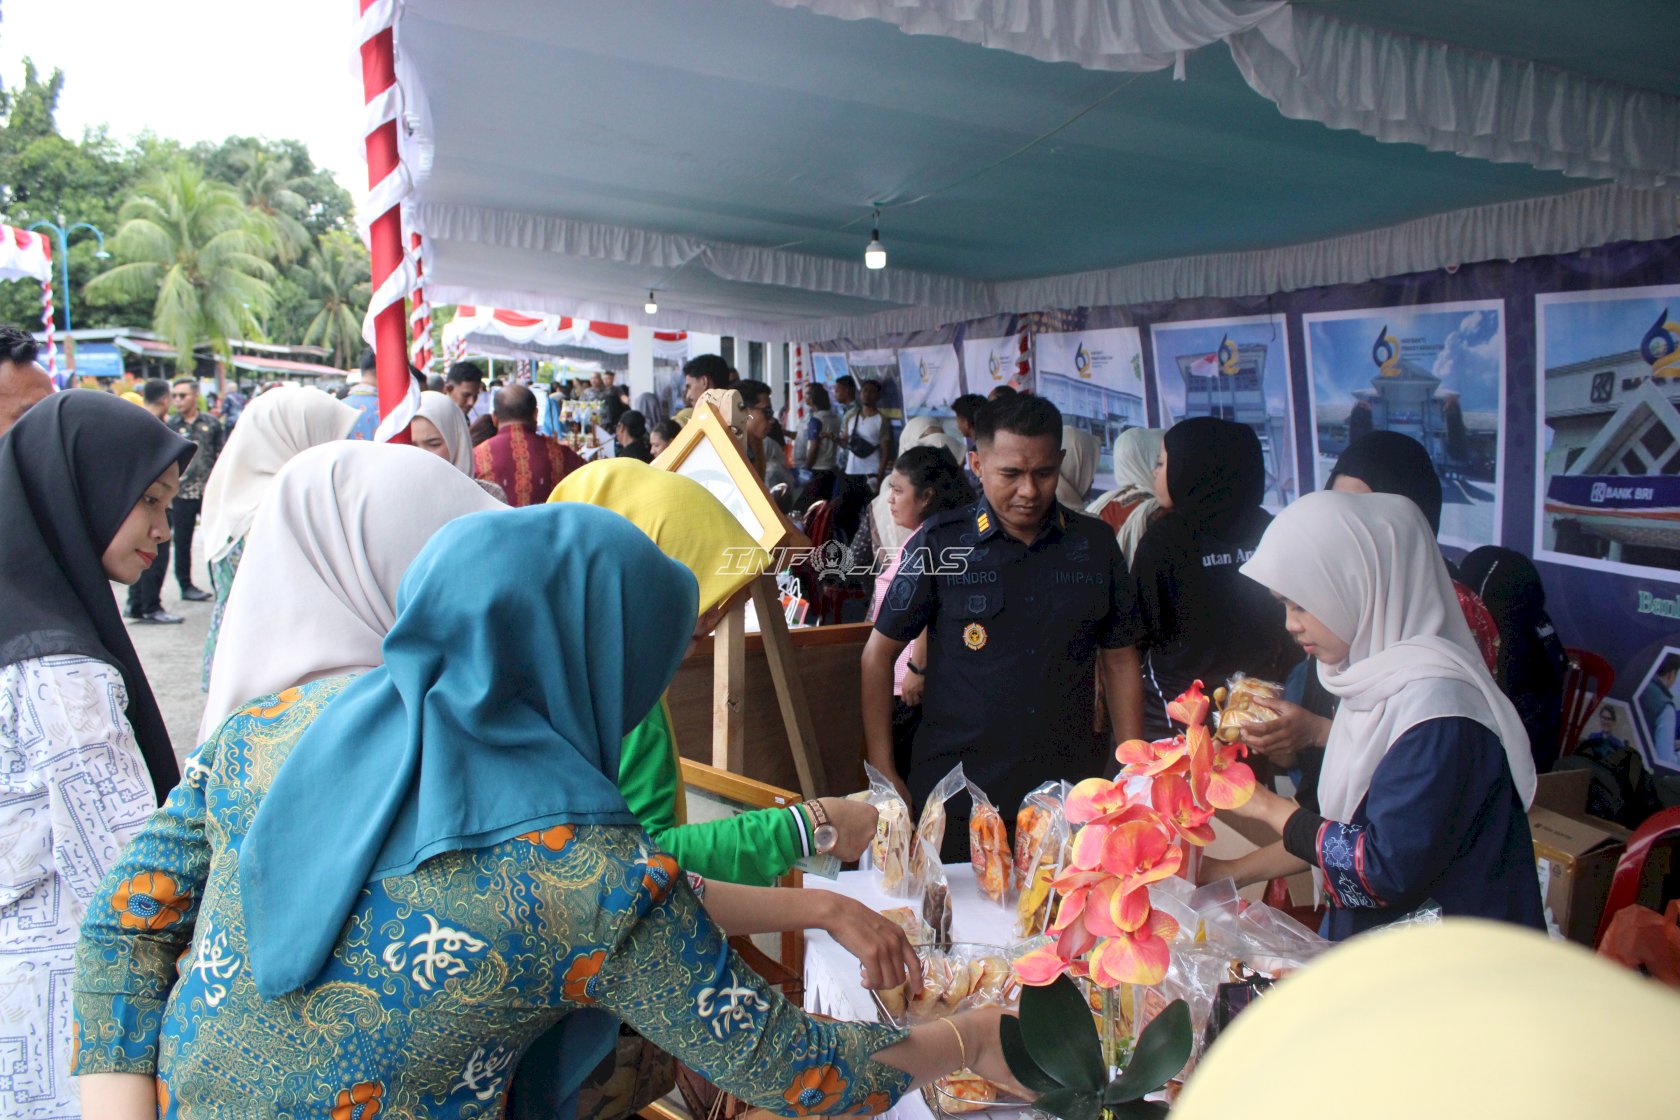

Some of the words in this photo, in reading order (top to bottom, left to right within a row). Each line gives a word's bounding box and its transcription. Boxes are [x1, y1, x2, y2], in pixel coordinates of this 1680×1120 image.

[1605, 487, 1633, 499] BANK
[1634, 488, 1654, 500] BRI
[947, 571, 997, 586] HENDRO
[1638, 590, 1680, 619] Ban
